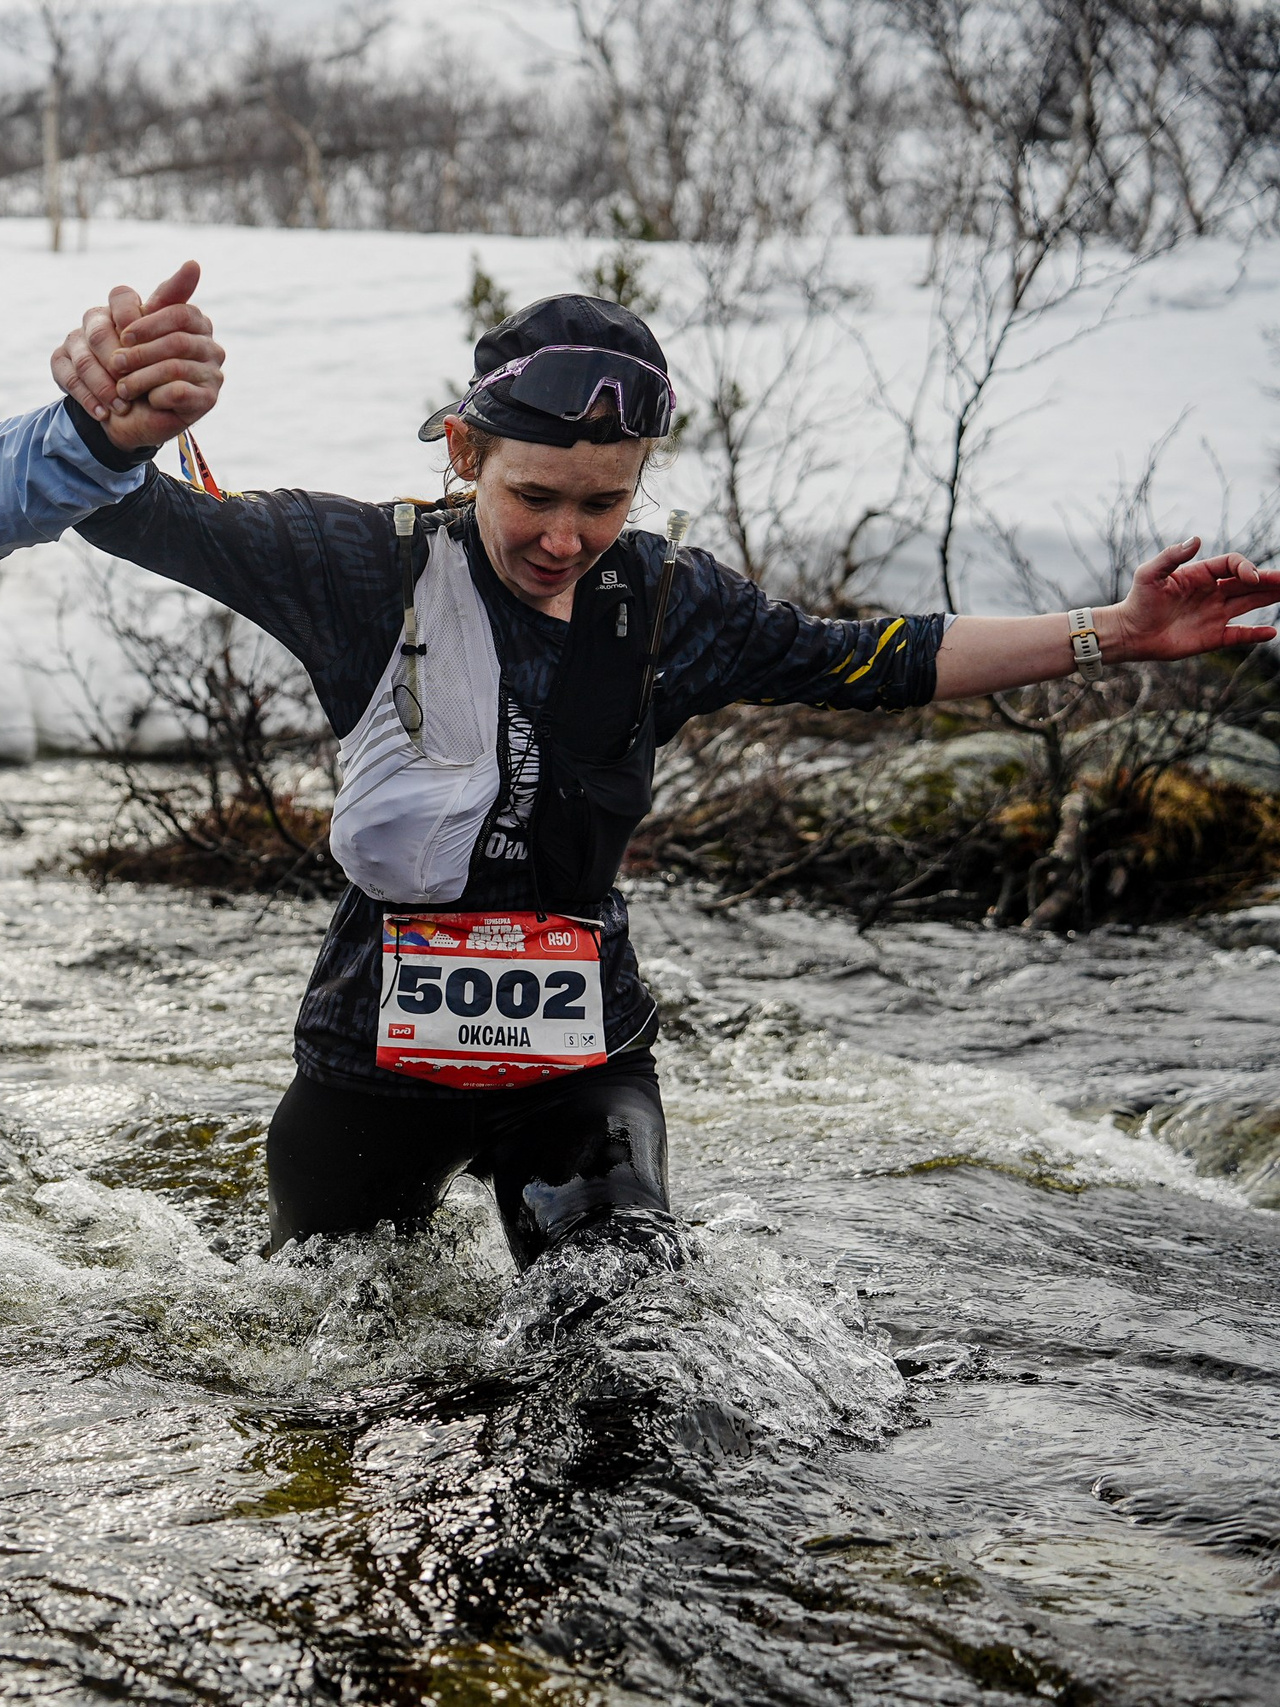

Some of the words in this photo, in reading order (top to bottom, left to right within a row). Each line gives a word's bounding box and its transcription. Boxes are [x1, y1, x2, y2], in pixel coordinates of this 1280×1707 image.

[472, 924, 523, 935] ULTRA
[468, 932, 526, 942] GRAND
[547, 932, 572, 946] R50
[465, 940, 526, 952] ESCAPE
[397, 964, 587, 1020] 5002
[458, 1024, 532, 1048] ОКСАНА
[568, 1035, 575, 1046] S
